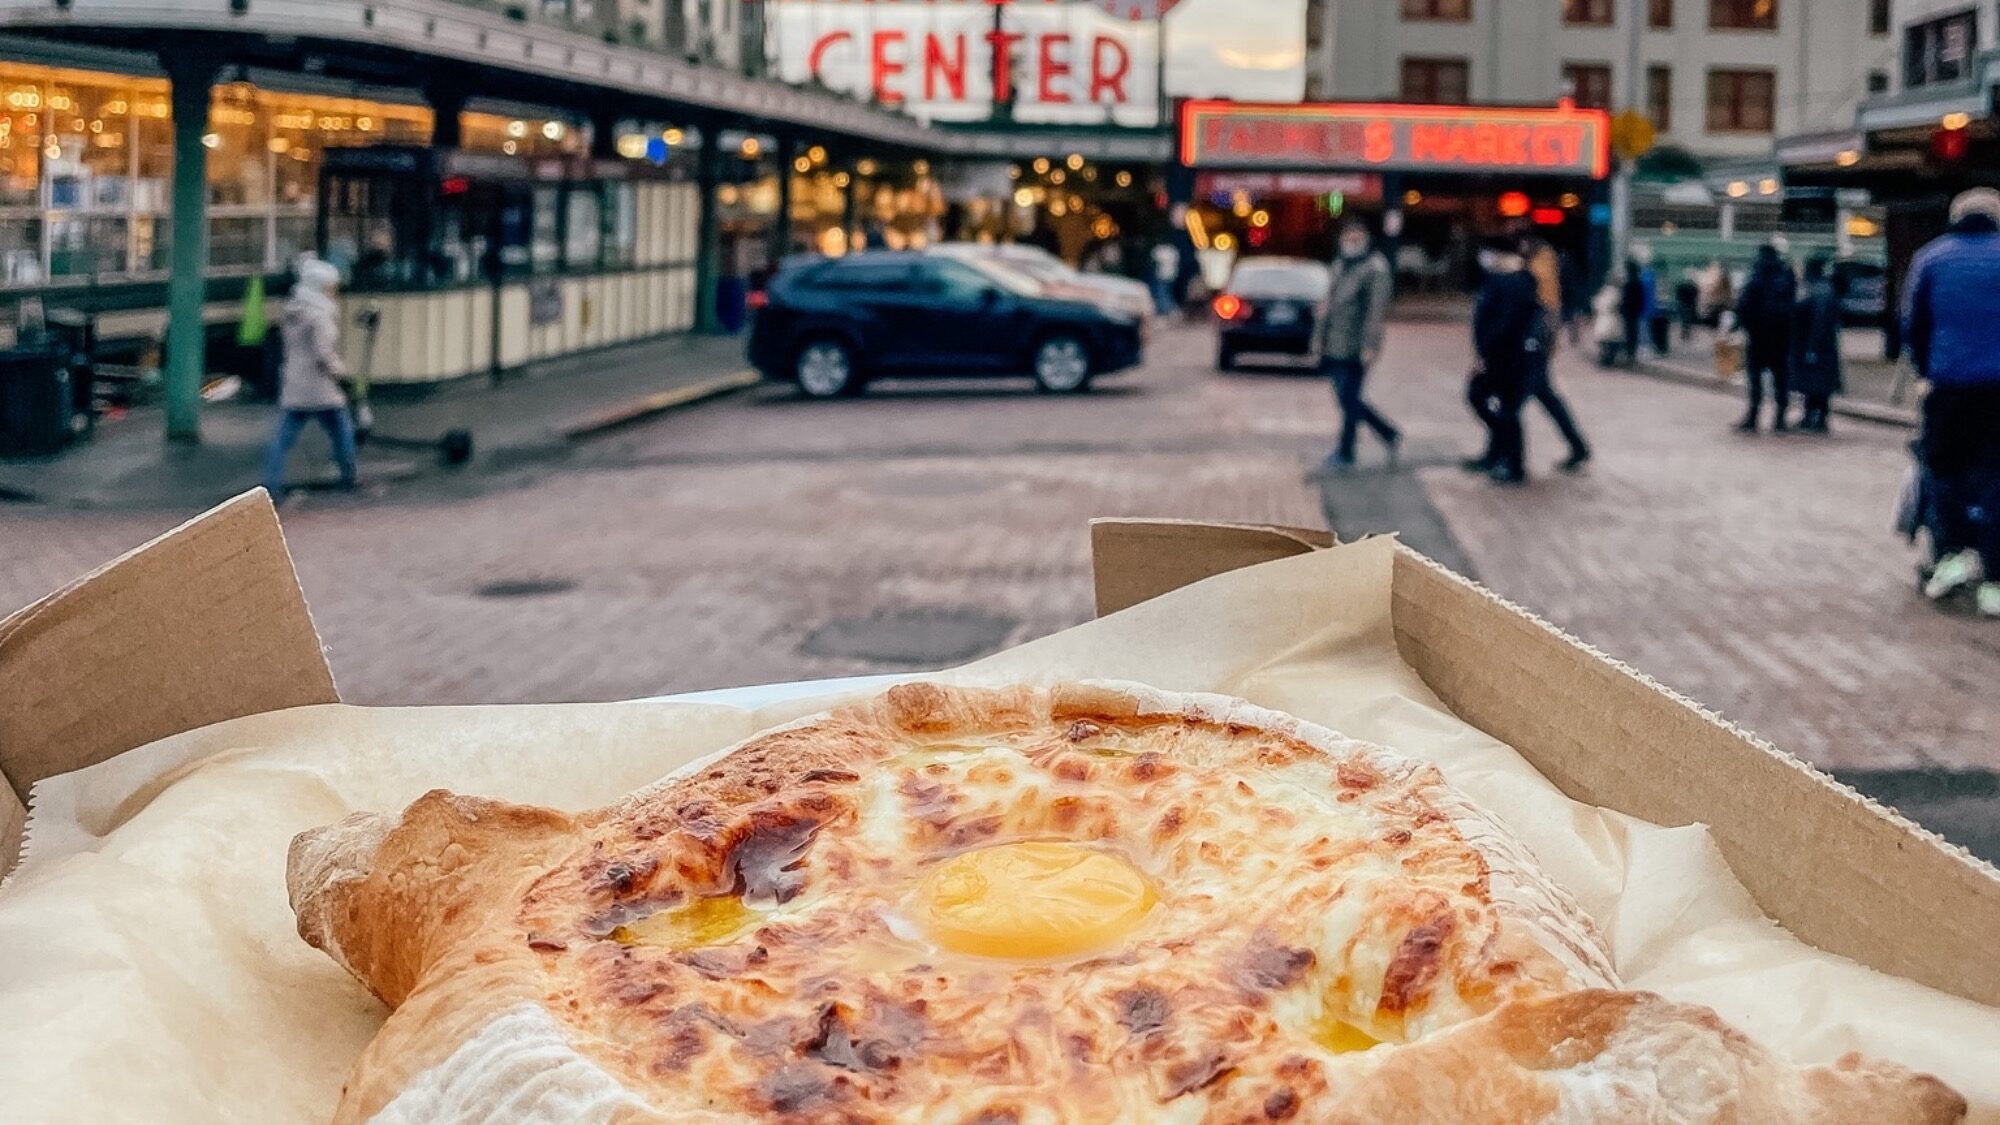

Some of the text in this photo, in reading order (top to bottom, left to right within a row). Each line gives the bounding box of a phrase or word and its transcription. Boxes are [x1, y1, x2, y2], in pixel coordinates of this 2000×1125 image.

[808, 30, 1129, 104] CENTER
[1206, 118, 1584, 167] FAMS MARKET
